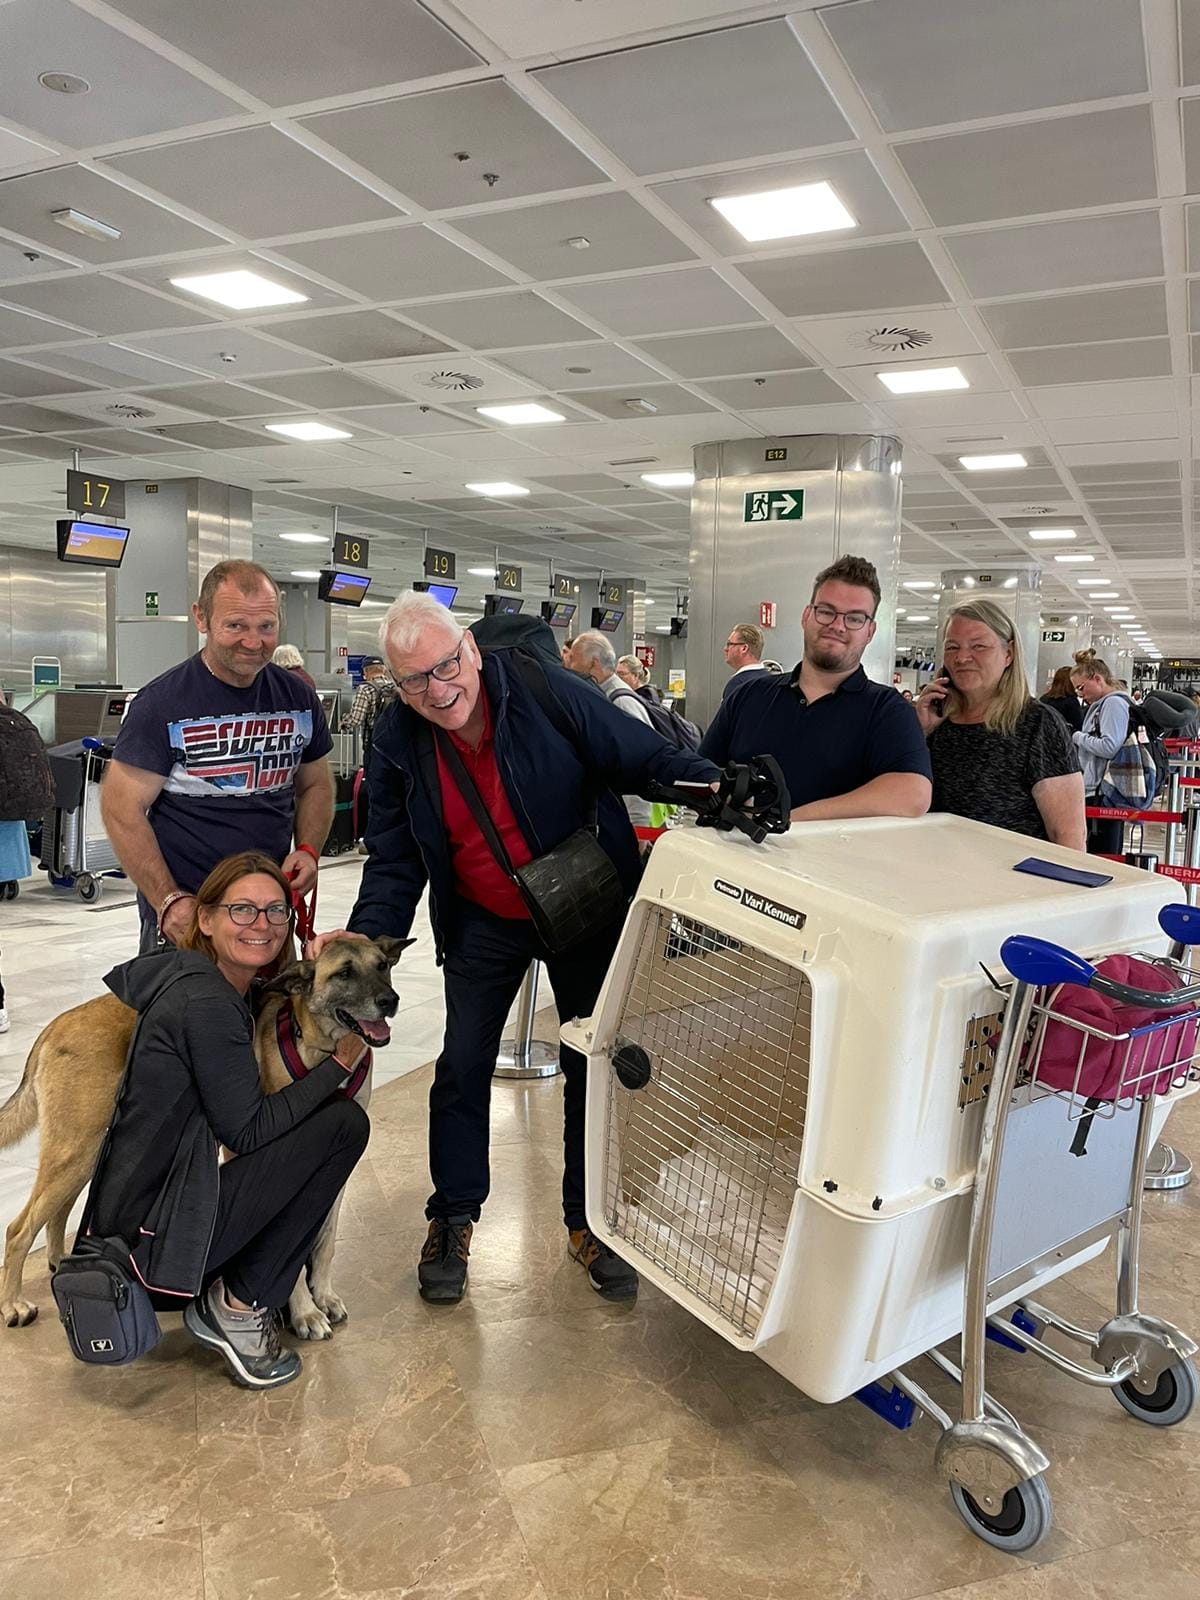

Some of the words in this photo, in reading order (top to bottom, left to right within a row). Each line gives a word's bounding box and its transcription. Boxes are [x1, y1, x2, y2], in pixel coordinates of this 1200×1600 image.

[768, 450, 785, 460] E12
[83, 481, 110, 508] 17
[343, 541, 361, 562] 18
[433, 555, 449, 574] 19
[503, 570, 517, 588] 20
[559, 579, 570, 594] 21
[609, 586, 619, 602] 22
[184, 718, 295, 760] SUPER
[745, 893, 764, 910] Vari
[763, 902, 800, 926] Kennel
